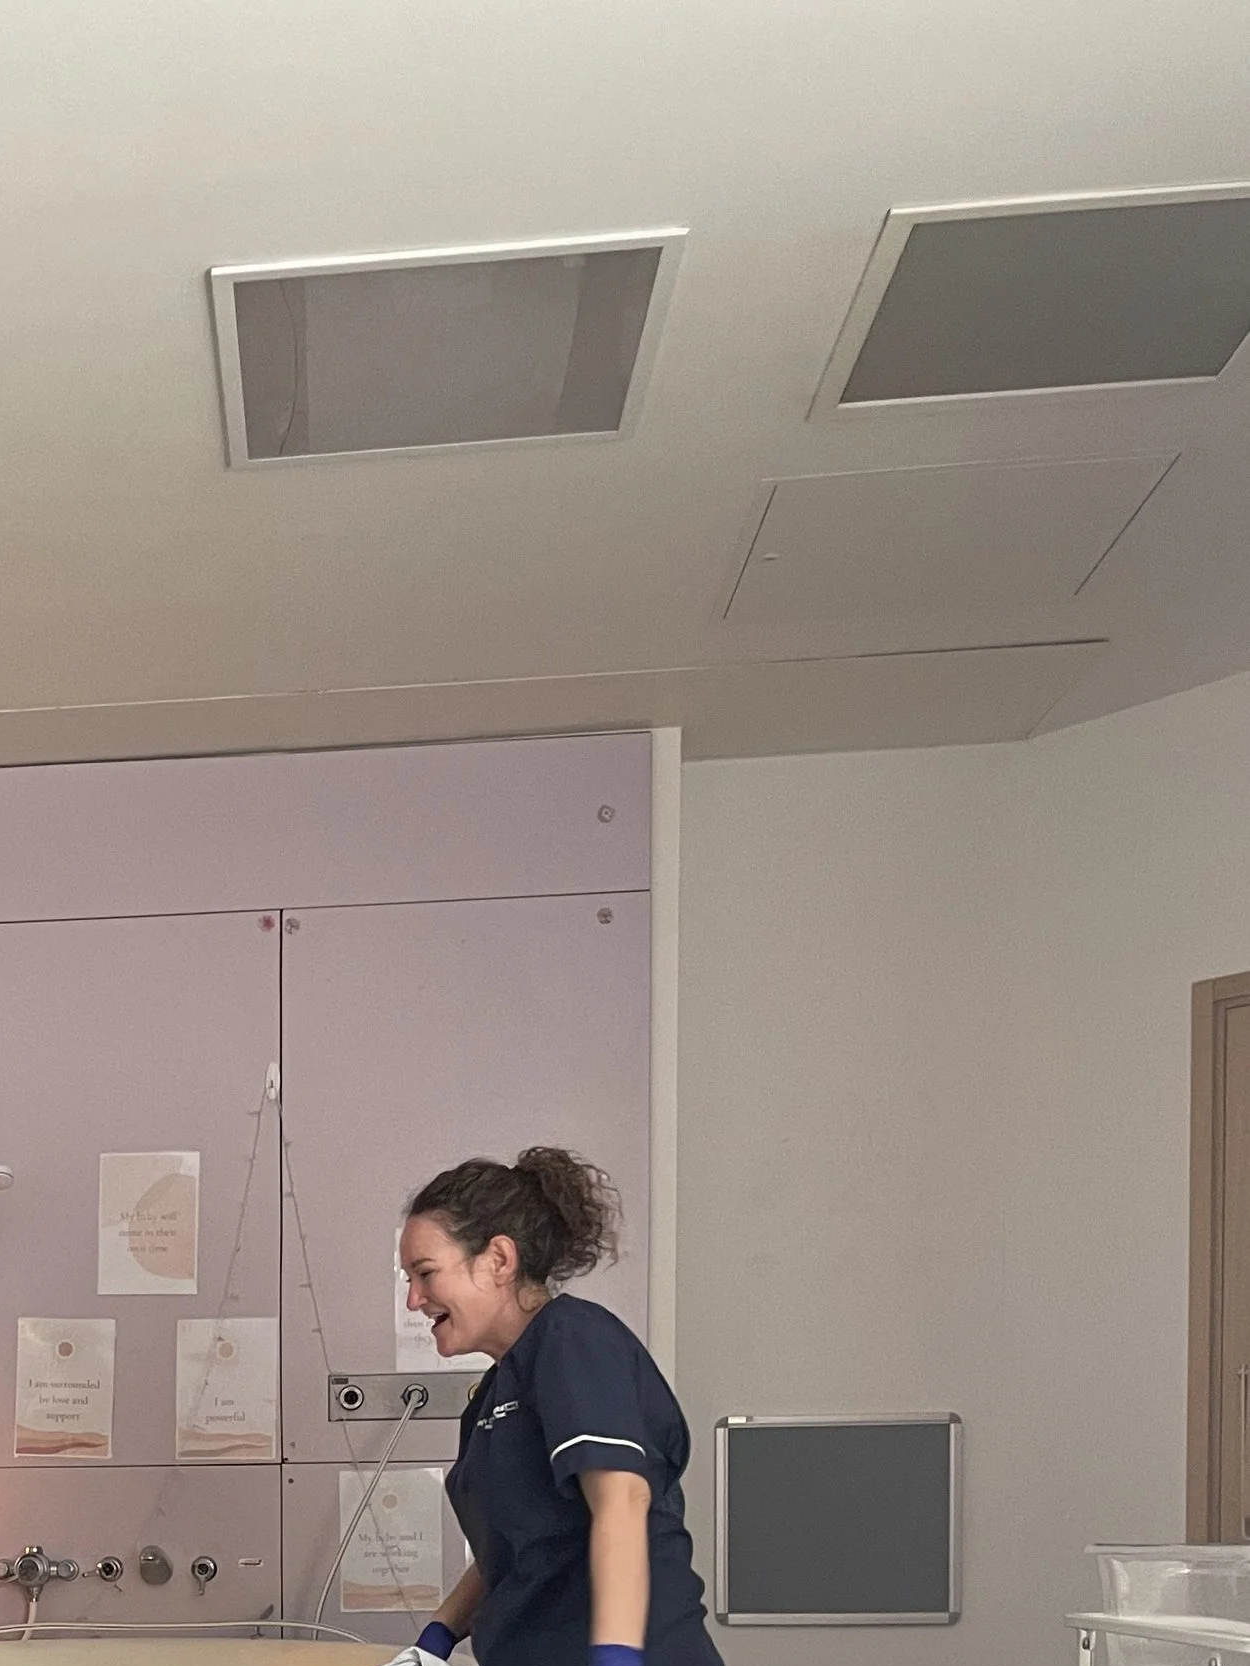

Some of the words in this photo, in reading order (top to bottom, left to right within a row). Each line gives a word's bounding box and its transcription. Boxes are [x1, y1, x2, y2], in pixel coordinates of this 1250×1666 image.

[50, 1379, 100, 1389] surrounded
[52, 1394, 70, 1405] love
[72, 1395, 89, 1405] and
[45, 1412, 80, 1423] support
[205, 1411, 245, 1425] powerful
[399, 1531, 417, 1541] and
[364, 1550, 377, 1558] are
